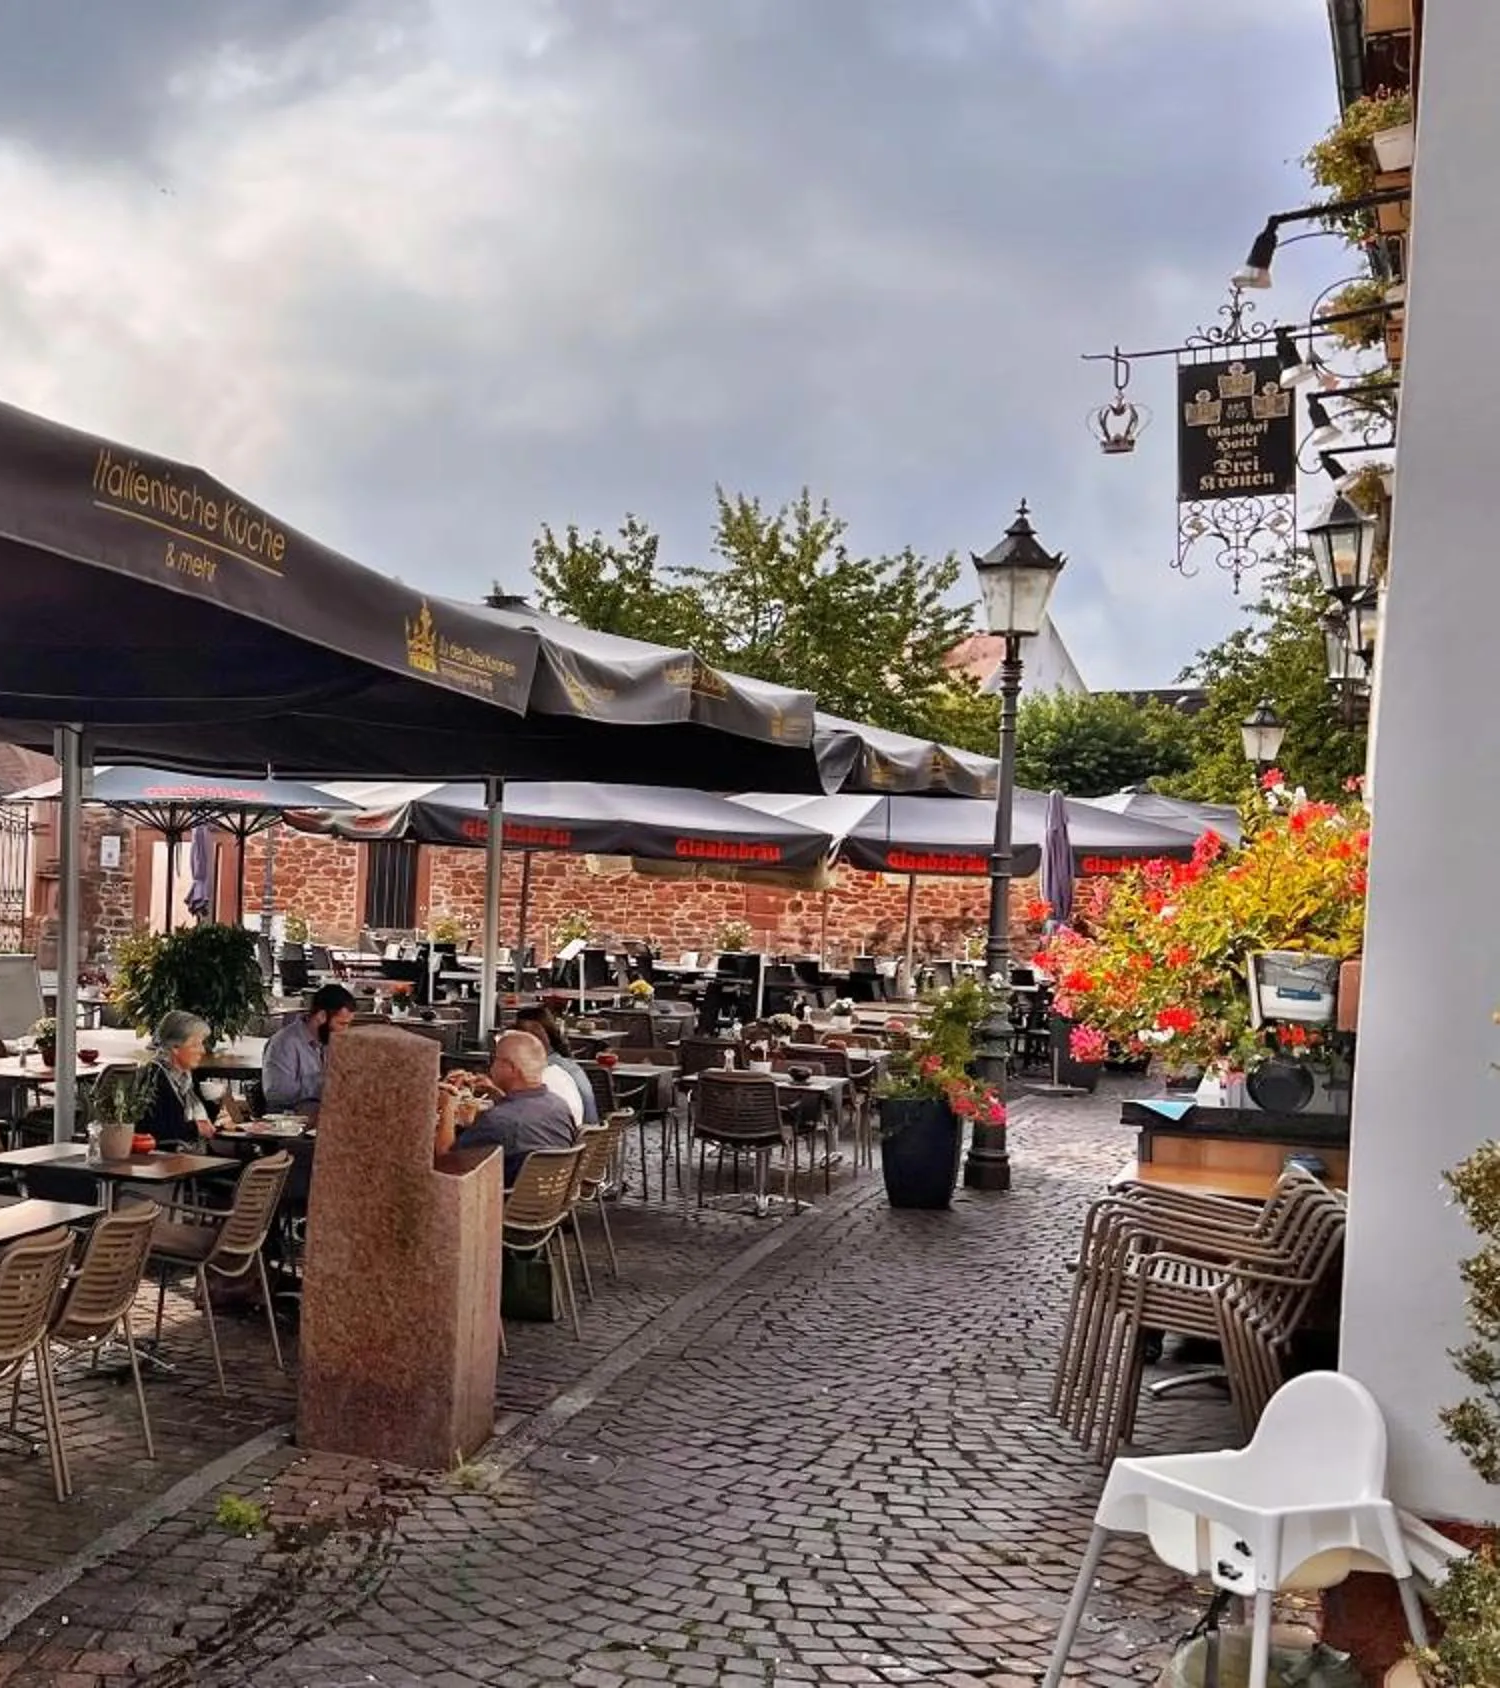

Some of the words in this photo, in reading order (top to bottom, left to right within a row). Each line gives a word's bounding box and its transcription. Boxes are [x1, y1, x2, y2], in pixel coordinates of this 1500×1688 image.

[1213, 455, 1260, 475] Drei
[1199, 472, 1276, 491] Kronen
[92, 448, 219, 531] Italienische
[222, 500, 286, 562] Küche
[164, 541, 176, 568] &
[177, 548, 218, 583] mehr
